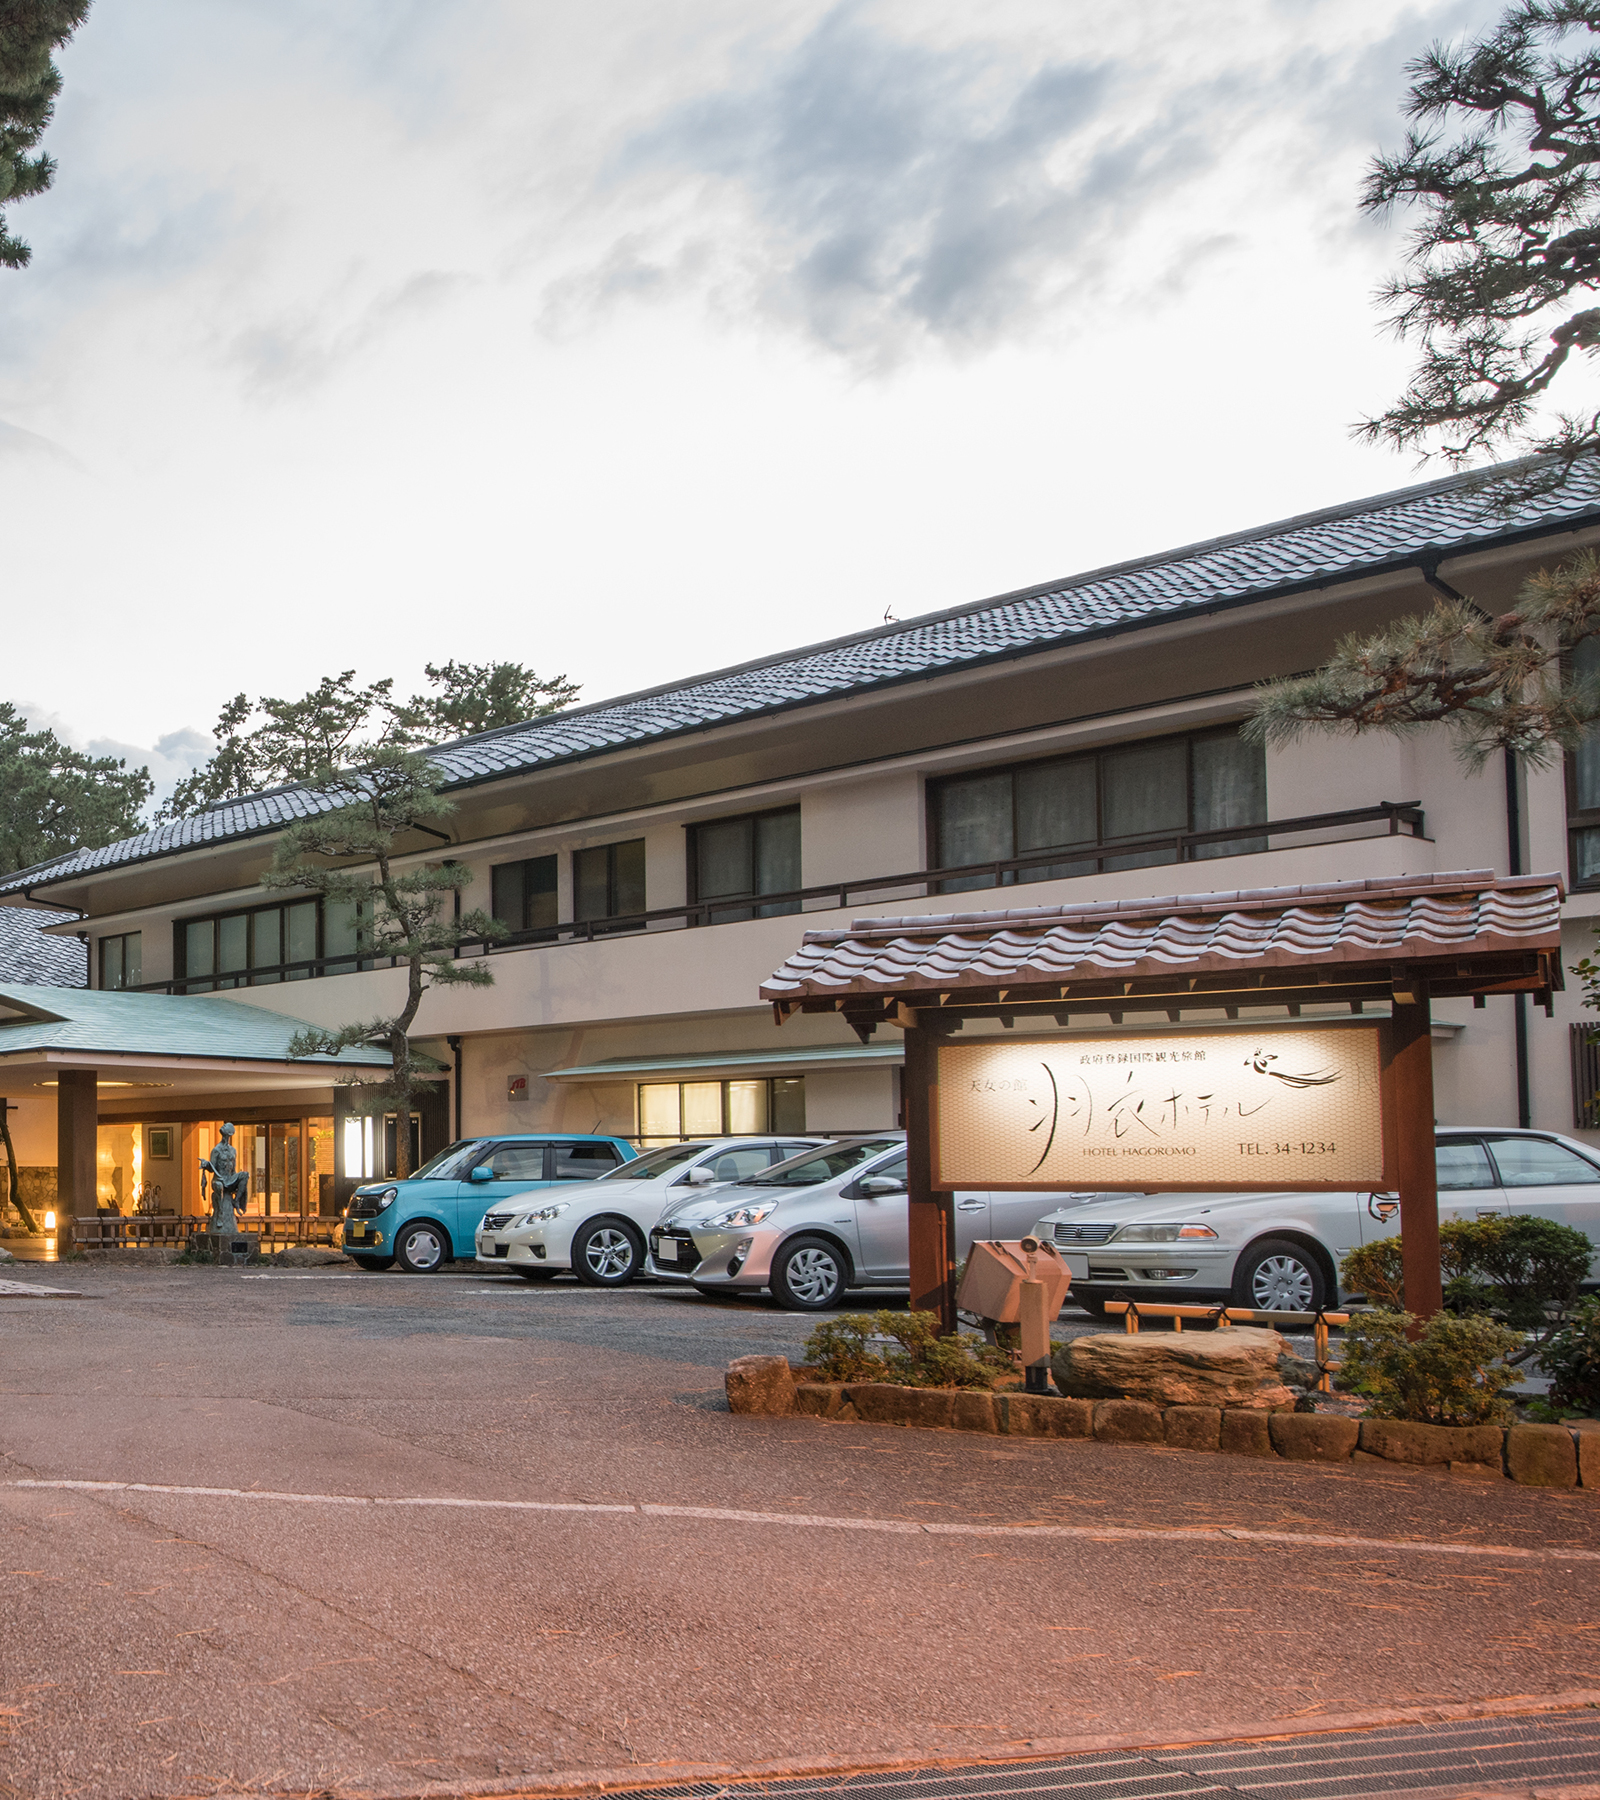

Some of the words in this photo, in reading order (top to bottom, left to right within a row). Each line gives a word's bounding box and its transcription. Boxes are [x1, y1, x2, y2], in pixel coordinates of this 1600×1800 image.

[1079, 1050, 1207, 1065] 政府登録国際観光旅館
[970, 1079, 1028, 1093] 天女の館
[1018, 1062, 1275, 1178] 羽衣ホテル
[1083, 1147, 1118, 1157] HOTEL
[1122, 1146, 1197, 1156] HAGOROMO
[1237, 1142, 1269, 1155] TEL.
[1271, 1141, 1337, 1155] 34-1234
